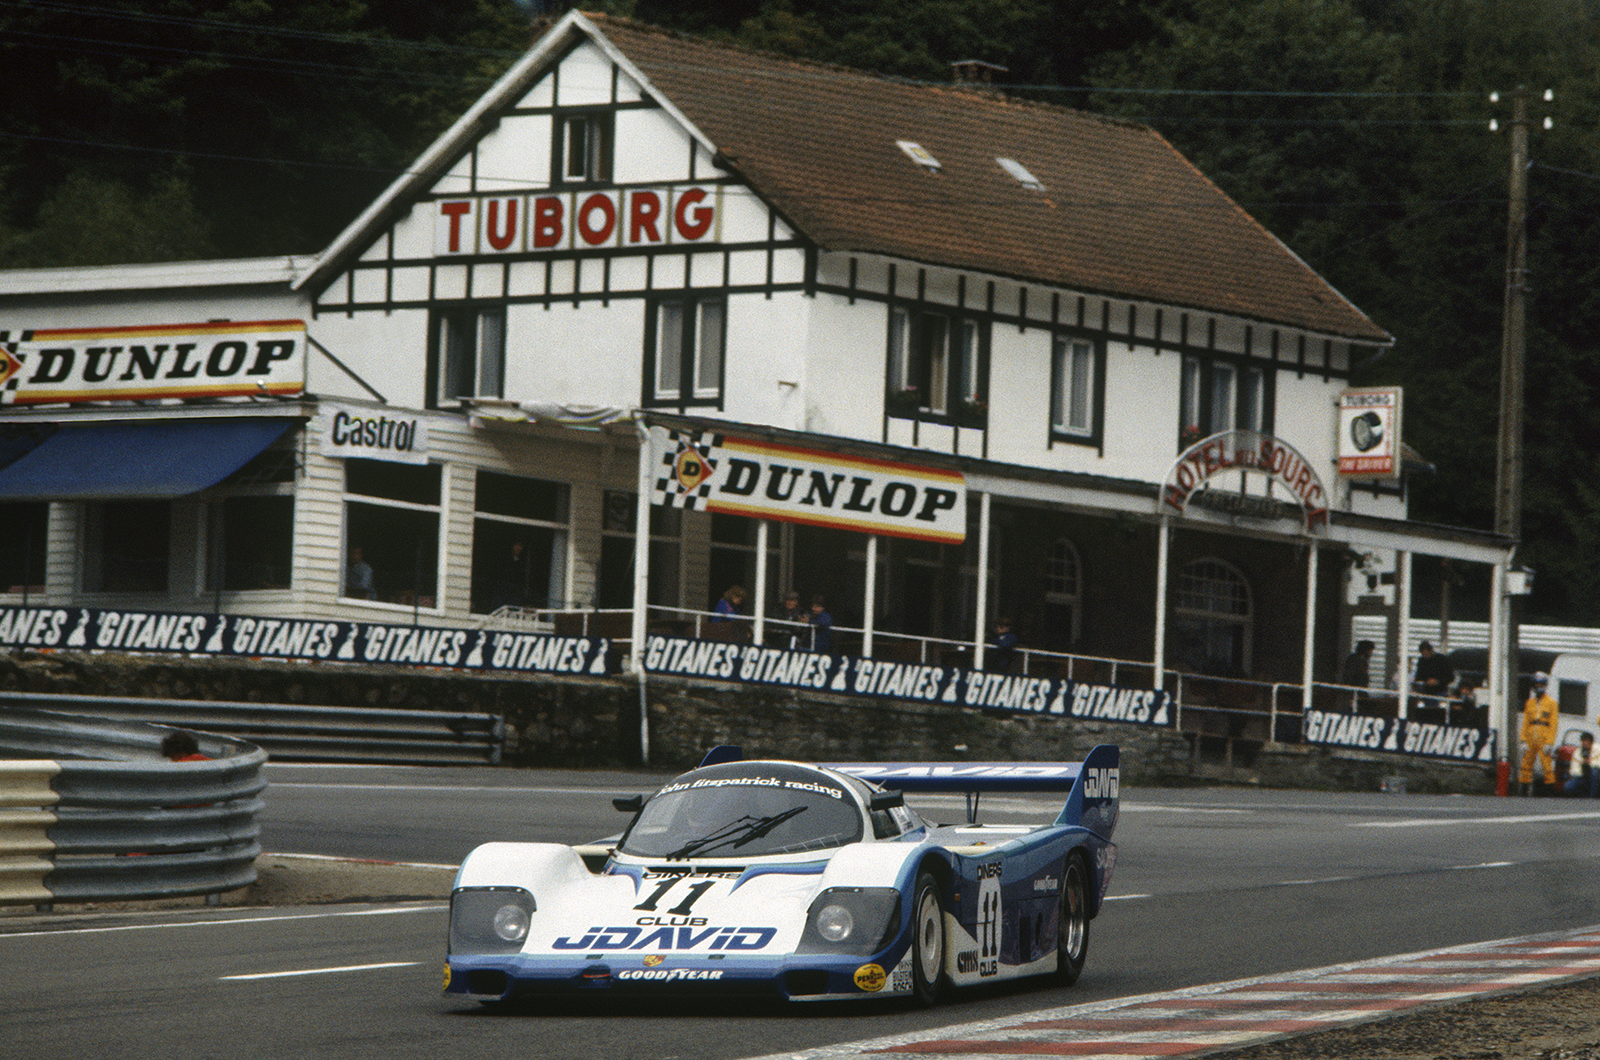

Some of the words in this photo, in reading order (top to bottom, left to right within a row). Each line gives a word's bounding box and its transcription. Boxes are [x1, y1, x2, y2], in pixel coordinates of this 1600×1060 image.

[440, 187, 715, 253] TUBORG
[28, 340, 295, 383] DUNLOP
[332, 411, 418, 452] Castrol
[719, 457, 958, 522] DUNLOP
[1163, 440, 1234, 512] HOTEL
[1257, 440, 1328, 531] SOURCE
[0, 608, 68, 646] ANES
[97, 611, 206, 650] GITANES
[232, 617, 338, 658] GITANES
[364, 625, 467, 667] GITANES
[491, 632, 591, 673] GITANES
[645, 635, 739, 678] GITANES
[739, 646, 832, 688] GITANES
[854, 659, 944, 700] GITANES
[964, 671, 1051, 713] GITANES
[1071, 683, 1155, 723] GITANES
[1306, 710, 1386, 749] GITANES
[1403, 721, 1480, 759] GITANES
[655, 783, 692, 798] john
[691, 776, 781, 789] fitzpatrick
[785, 780, 843, 799] racing
[633, 877, 717, 916] 11
[642, 872, 741, 880] DINERS
[636, 917, 708, 926] CLUB
[982, 891, 998, 957] 11
[618, 968, 724, 983] GOODYEAR
